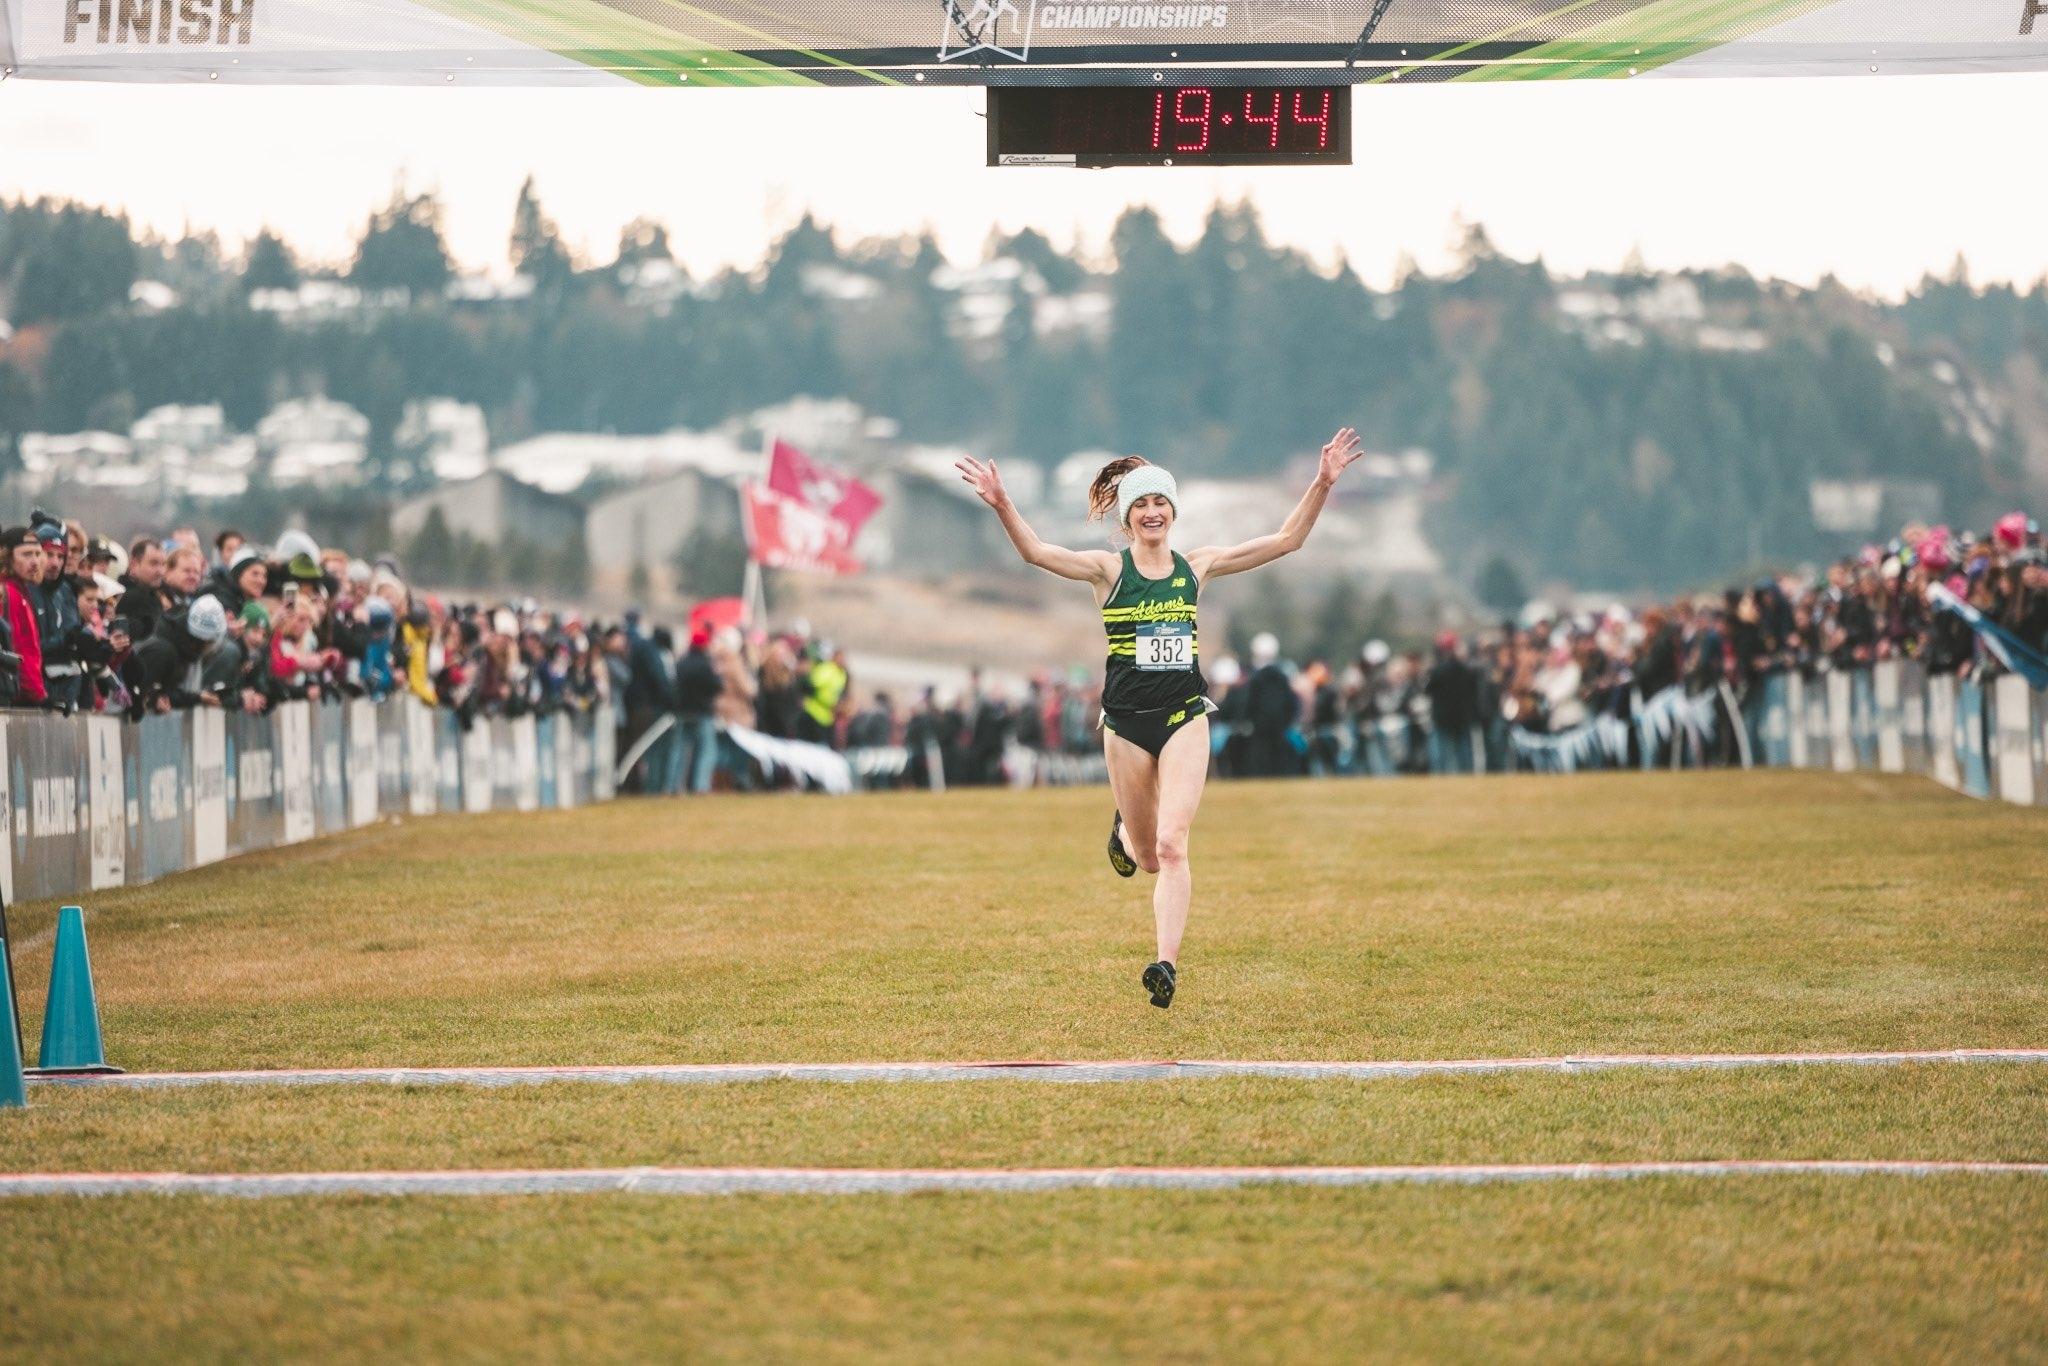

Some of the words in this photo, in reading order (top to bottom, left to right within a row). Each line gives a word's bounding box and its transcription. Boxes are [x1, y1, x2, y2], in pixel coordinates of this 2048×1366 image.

[63, 0, 255, 44] FINISH
[1040, 5, 1228, 29] CHAMPIONSHIPS
[1130, 595, 1185, 621] Adams
[1150, 637, 1184, 663] 352
